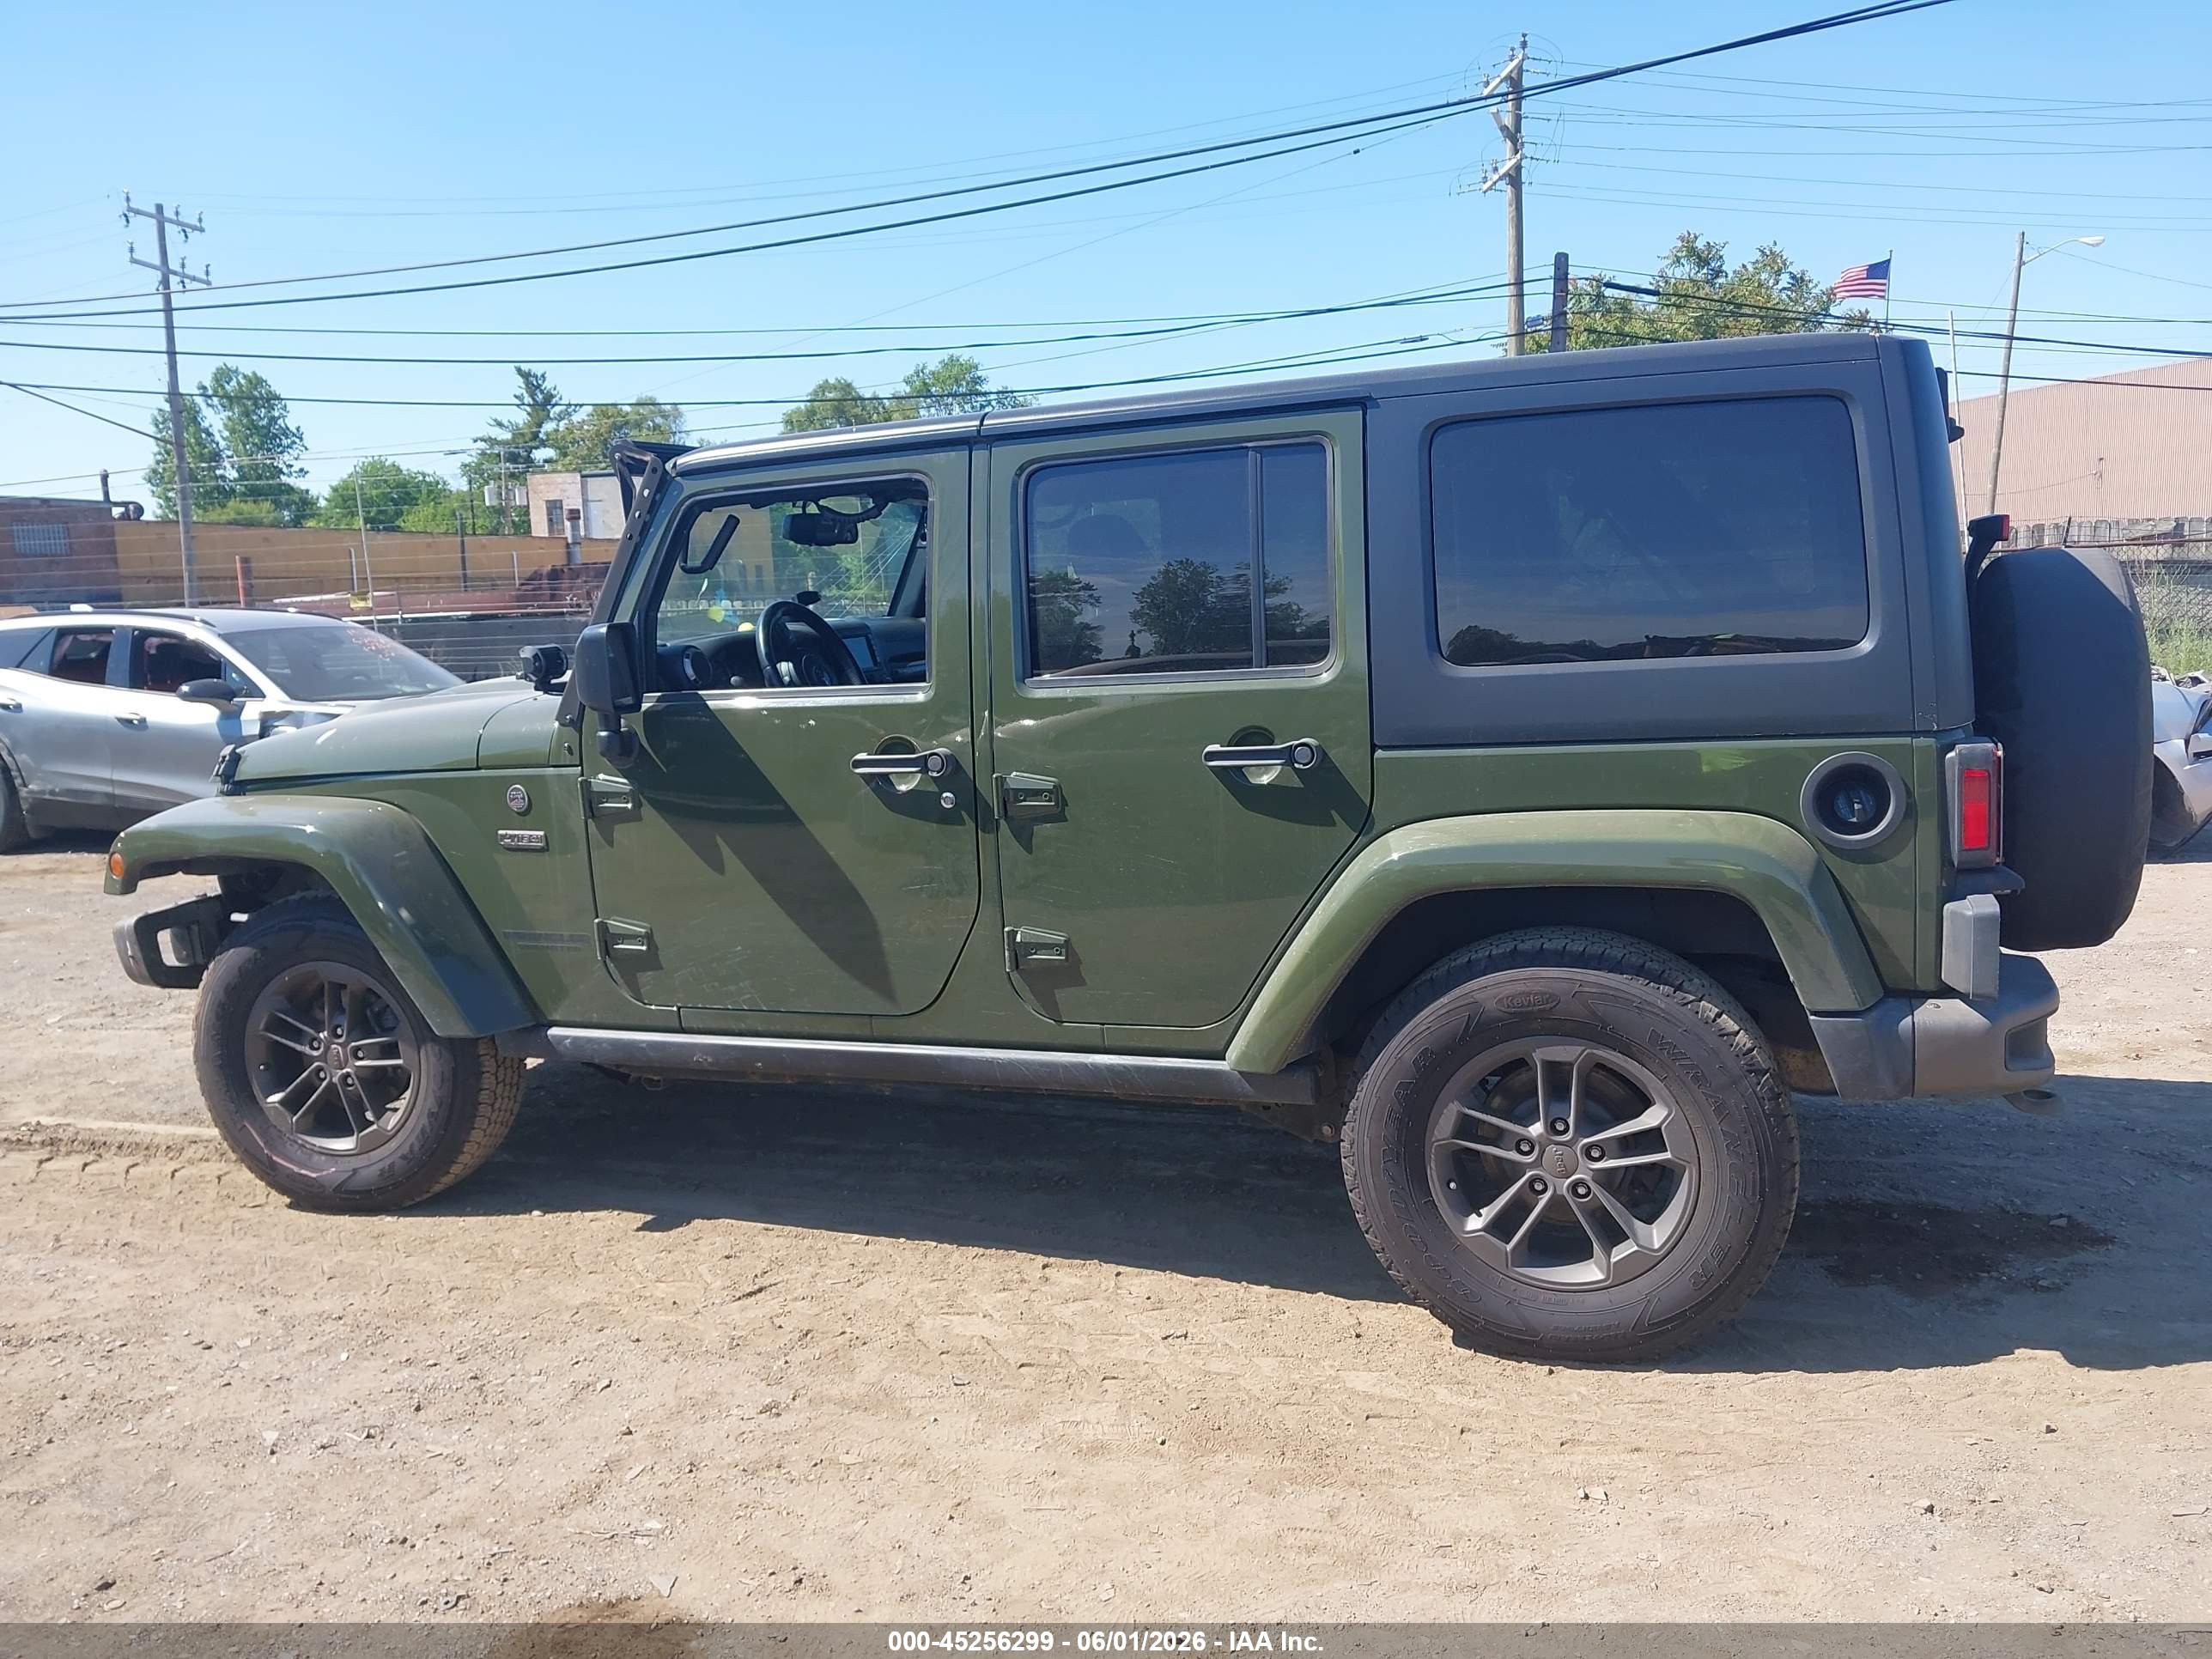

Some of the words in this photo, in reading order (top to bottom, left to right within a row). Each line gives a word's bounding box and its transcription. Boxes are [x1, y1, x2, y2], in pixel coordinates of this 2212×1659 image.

[1504, 994, 1551, 1009] Kevlar
[1381, 1045, 1482, 1303] GOODYEAR
[1552, 1147, 1566, 1175] Jeep
[1645, 1027, 1746, 1290] WRANGLER
